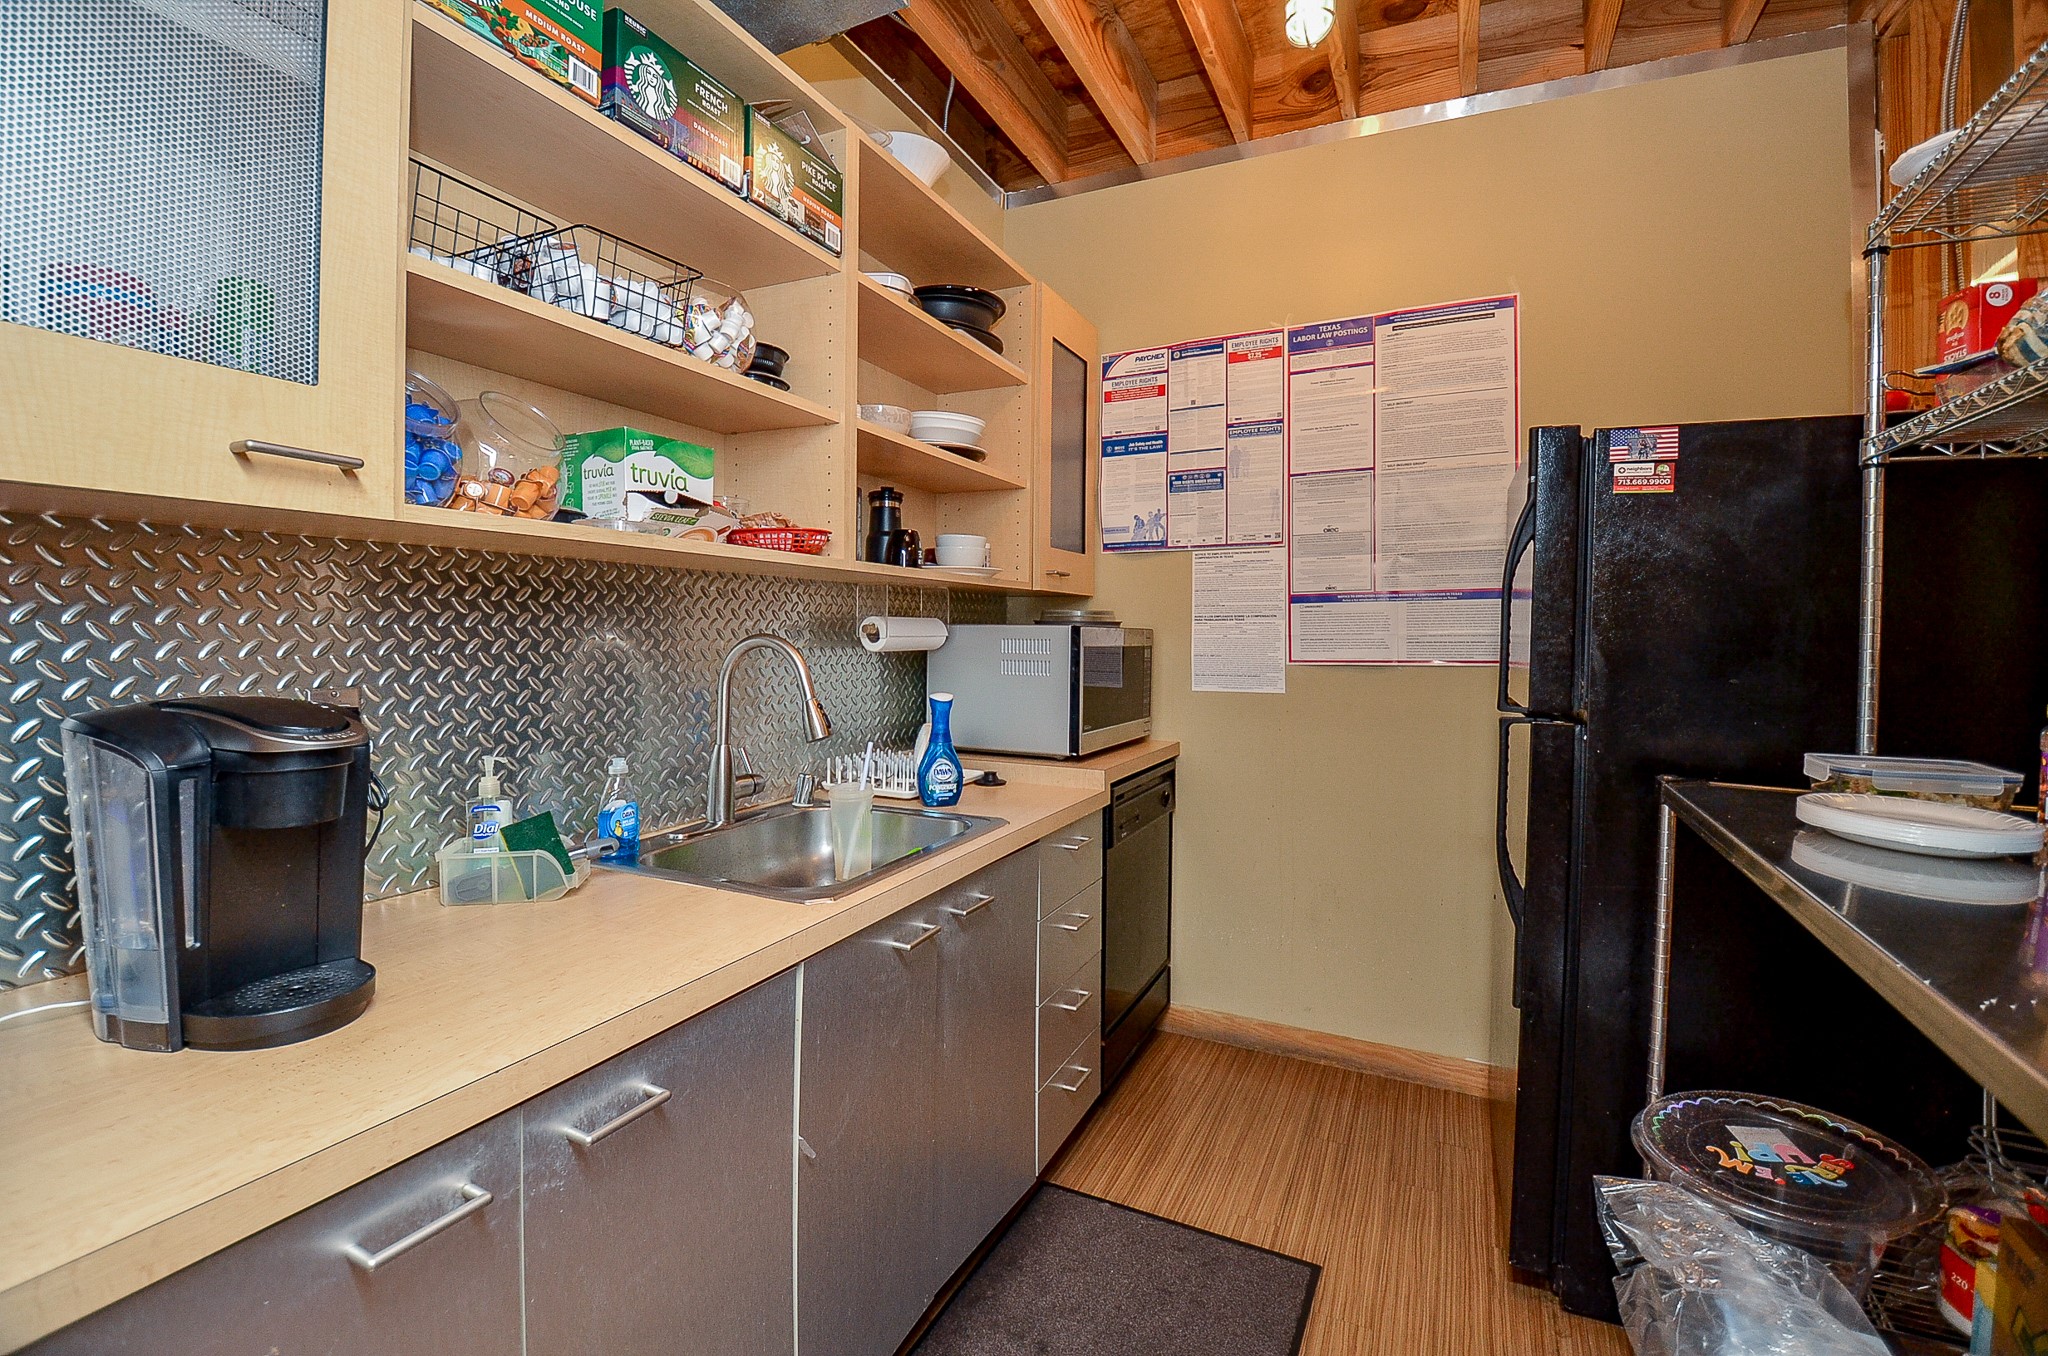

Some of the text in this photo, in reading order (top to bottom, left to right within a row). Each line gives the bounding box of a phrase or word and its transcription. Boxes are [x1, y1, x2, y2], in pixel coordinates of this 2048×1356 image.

[525, 9, 560, 38] MEDIUM
[560, 33, 586, 54] ROAST
[624, 14, 647, 34] KEURIG
[694, 83, 729, 114] FRENCH
[701, 99, 721, 117] ROAST
[693, 121, 729, 149] DARK ROAST
[801, 160, 816, 178] PIKE
[816, 172, 837, 193] PLACE
[811, 177, 826, 192] ROAST
[802, 195, 834, 221] MEDIUM ROAST
[1988, 291, 2001, 299] 8
[1292, 326, 1368, 343] LABOR LAW POSTINGS
[1319, 323, 1341, 332] TEXAS
[1231, 340, 1258, 349] EMPLOYEE
[1259, 336, 1279, 345] RIGHTS
[1135, 352, 1166, 362] PAYCHEX
[1111, 376, 1158, 388] EMPLOYEE RIGHTS
[1229, 427, 1258, 435] EMPLOYEE
[652, 513, 692, 524] STEVIA LEAF
[933, 768, 952, 776] DAWN
[474, 823, 500, 834] Dial
[1950, 1272, 1969, 1290] 220
